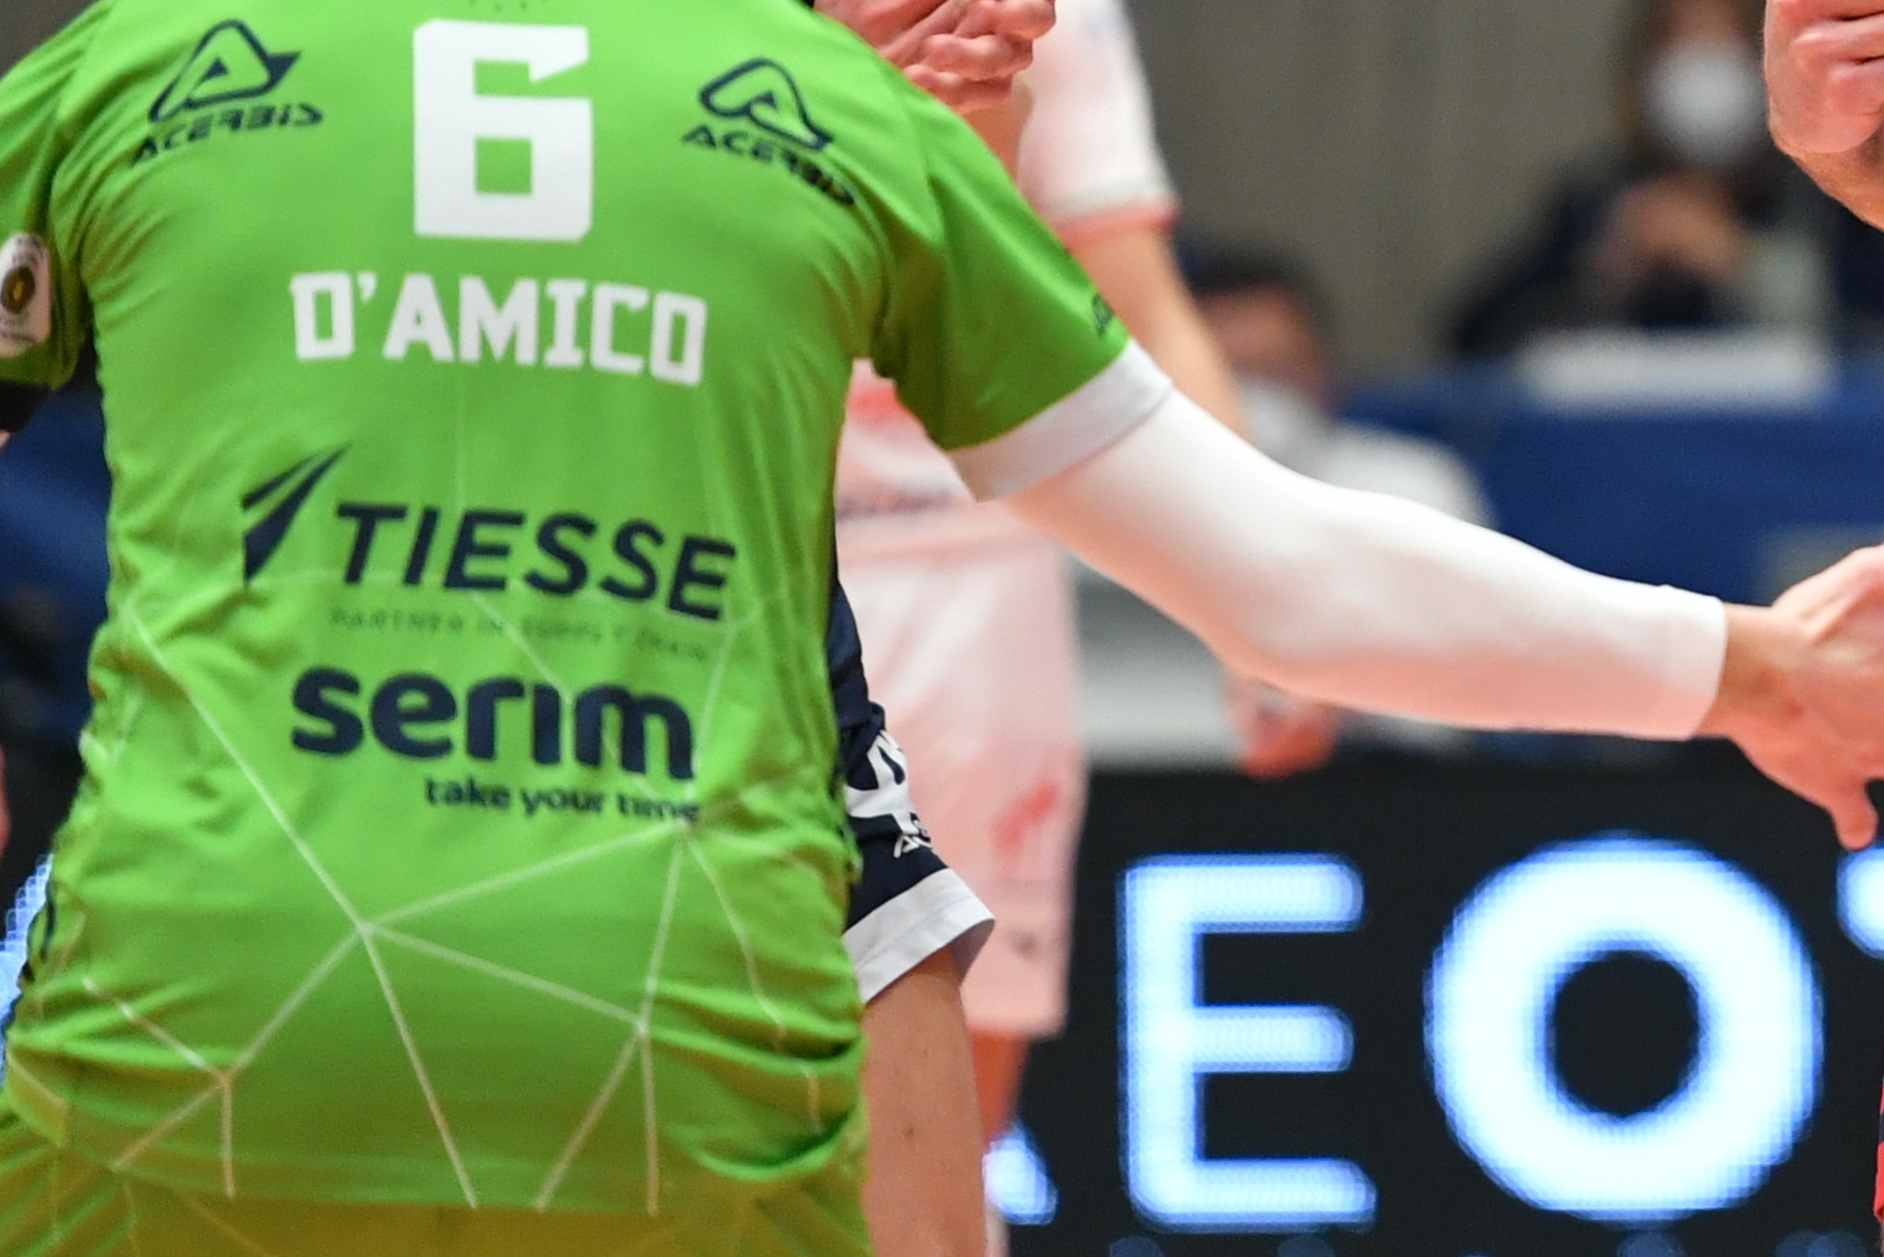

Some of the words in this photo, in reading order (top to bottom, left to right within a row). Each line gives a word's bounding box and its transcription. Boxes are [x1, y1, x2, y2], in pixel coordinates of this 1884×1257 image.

[413, 18, 594, 243] 6
[289, 271, 708, 387] D'AMICO
[336, 501, 738, 622] TIESSE
[290, 665, 698, 781] serim
[425, 776, 511, 811] take
[520, 785, 605, 818] your
[618, 792, 700, 822] time
